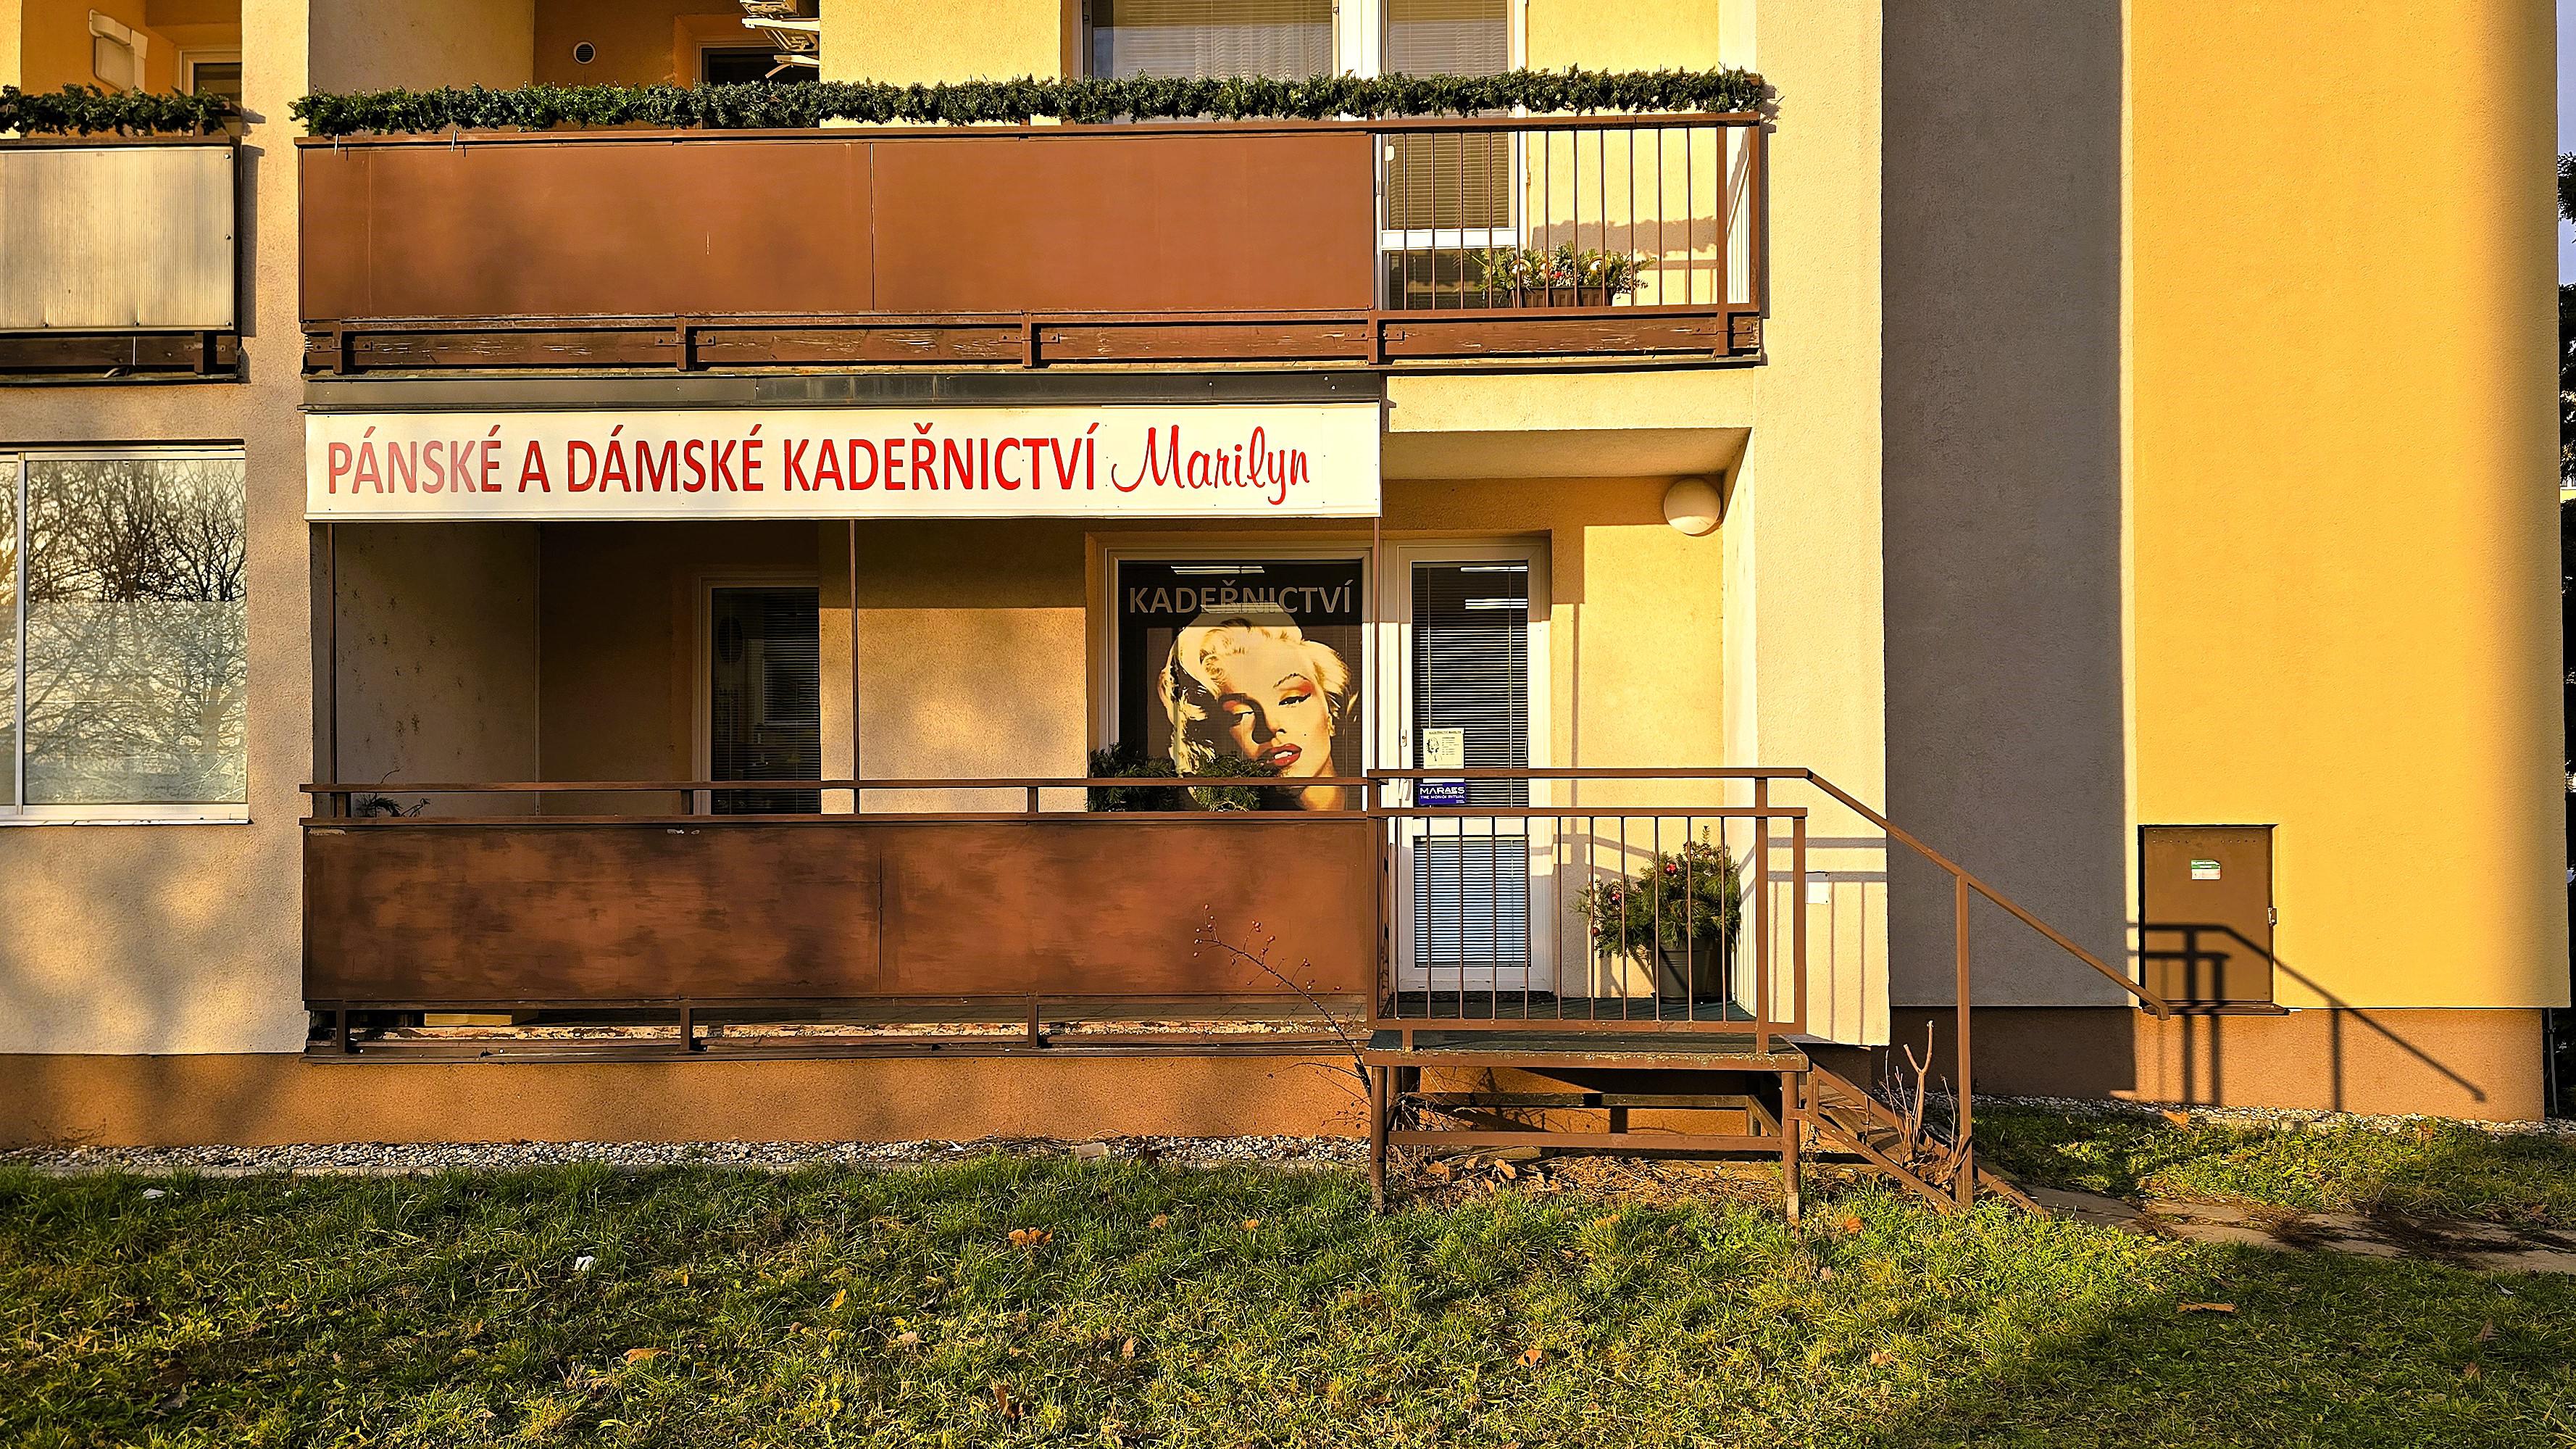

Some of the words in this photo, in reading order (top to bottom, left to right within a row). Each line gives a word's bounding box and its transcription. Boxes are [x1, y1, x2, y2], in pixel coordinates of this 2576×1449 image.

[328, 425, 502, 494] PÁNSKÉ
[518, 440, 551, 494] A
[567, 424, 764, 494] DÁMSKÉ
[784, 422, 1100, 492] KADEŘNICTVÍ
[1112, 424, 1311, 506] Marilyn
[1129, 579, 1354, 614] KADEŘNICTVÍ
